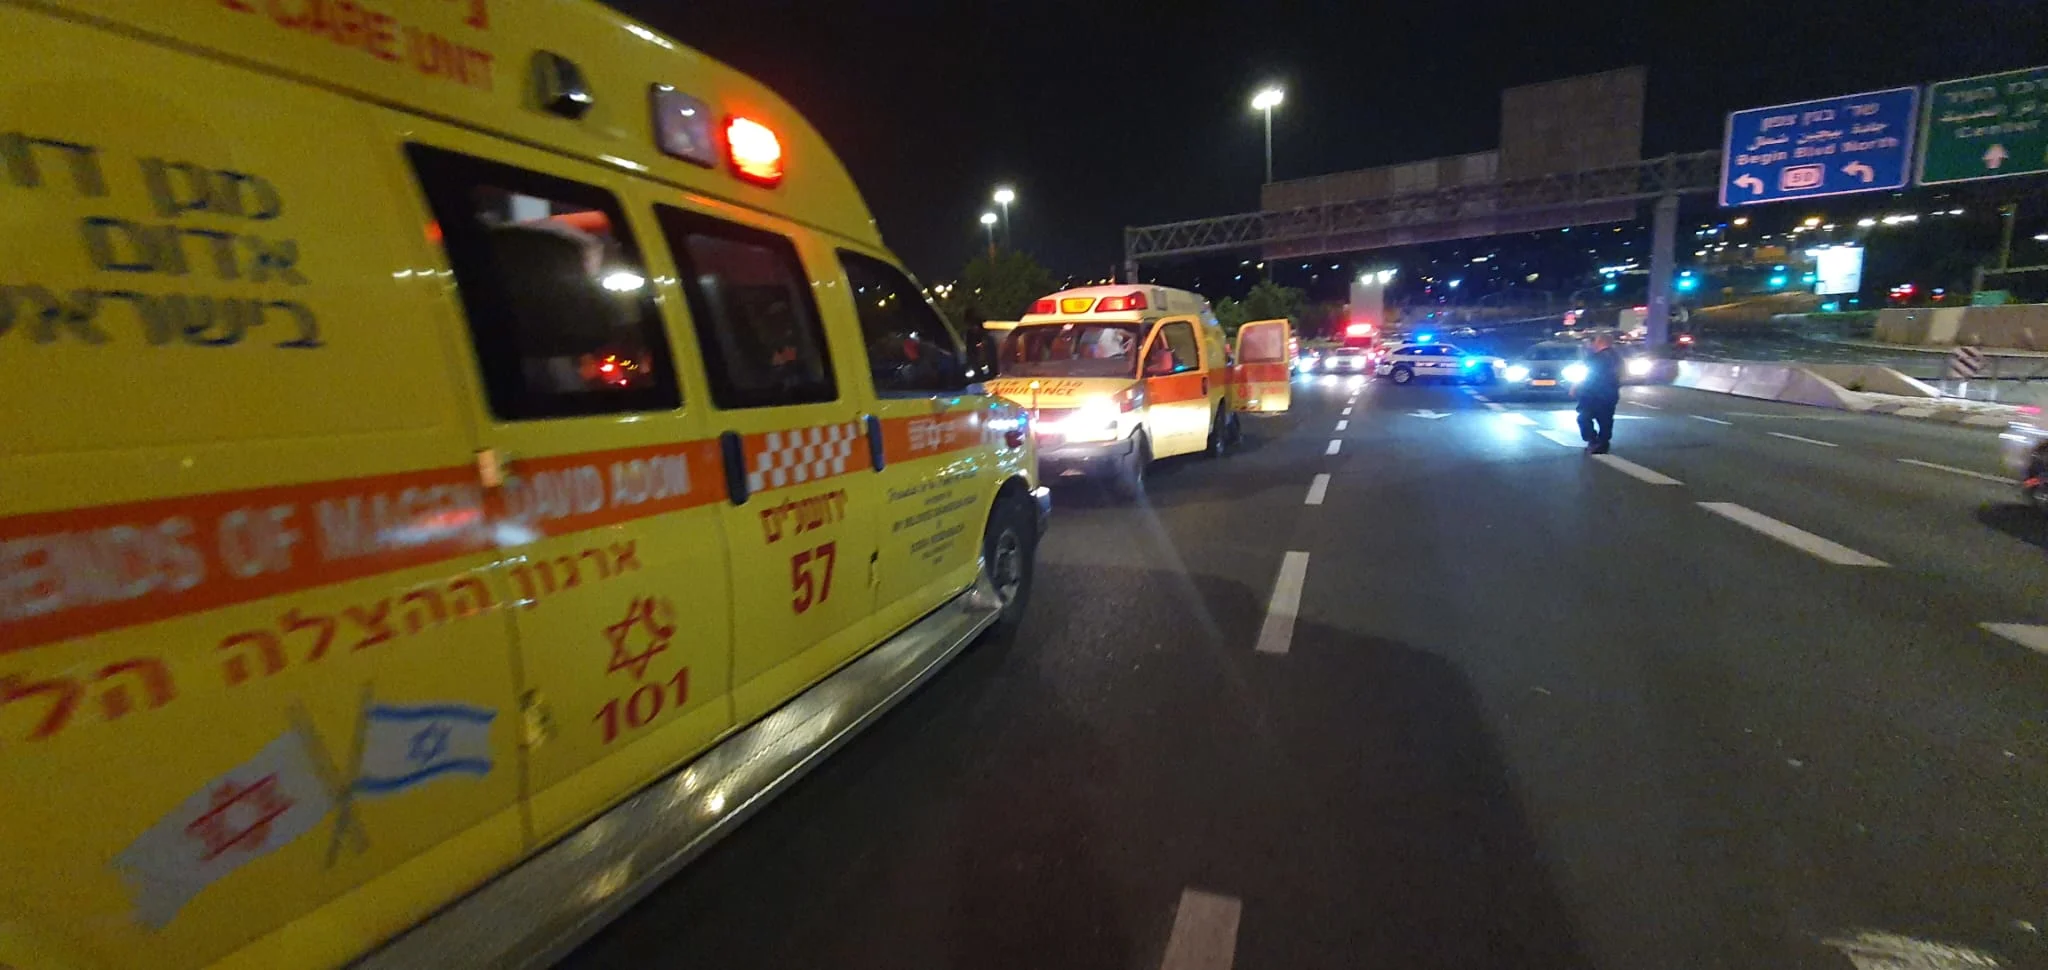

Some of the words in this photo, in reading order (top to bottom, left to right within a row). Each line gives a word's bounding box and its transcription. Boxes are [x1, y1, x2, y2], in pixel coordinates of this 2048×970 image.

[402, 25, 494, 92] UNIT
[1735, 151, 1788, 166] Begin
[1794, 143, 1836, 158] Blvd
[1841, 137, 1899, 153] North
[1792, 171, 1813, 184] 50
[138, 156, 283, 220] מגן
[82, 216, 311, 287] אדום
[218, 504, 301, 578] OF
[609, 451, 692, 508] ADOM
[760, 488, 850, 544] ירושלים
[509, 538, 643, 609] ארגון
[790, 540, 837, 615] 57
[217, 575, 494, 687] ההצלה
[592, 667, 690, 746] 101
